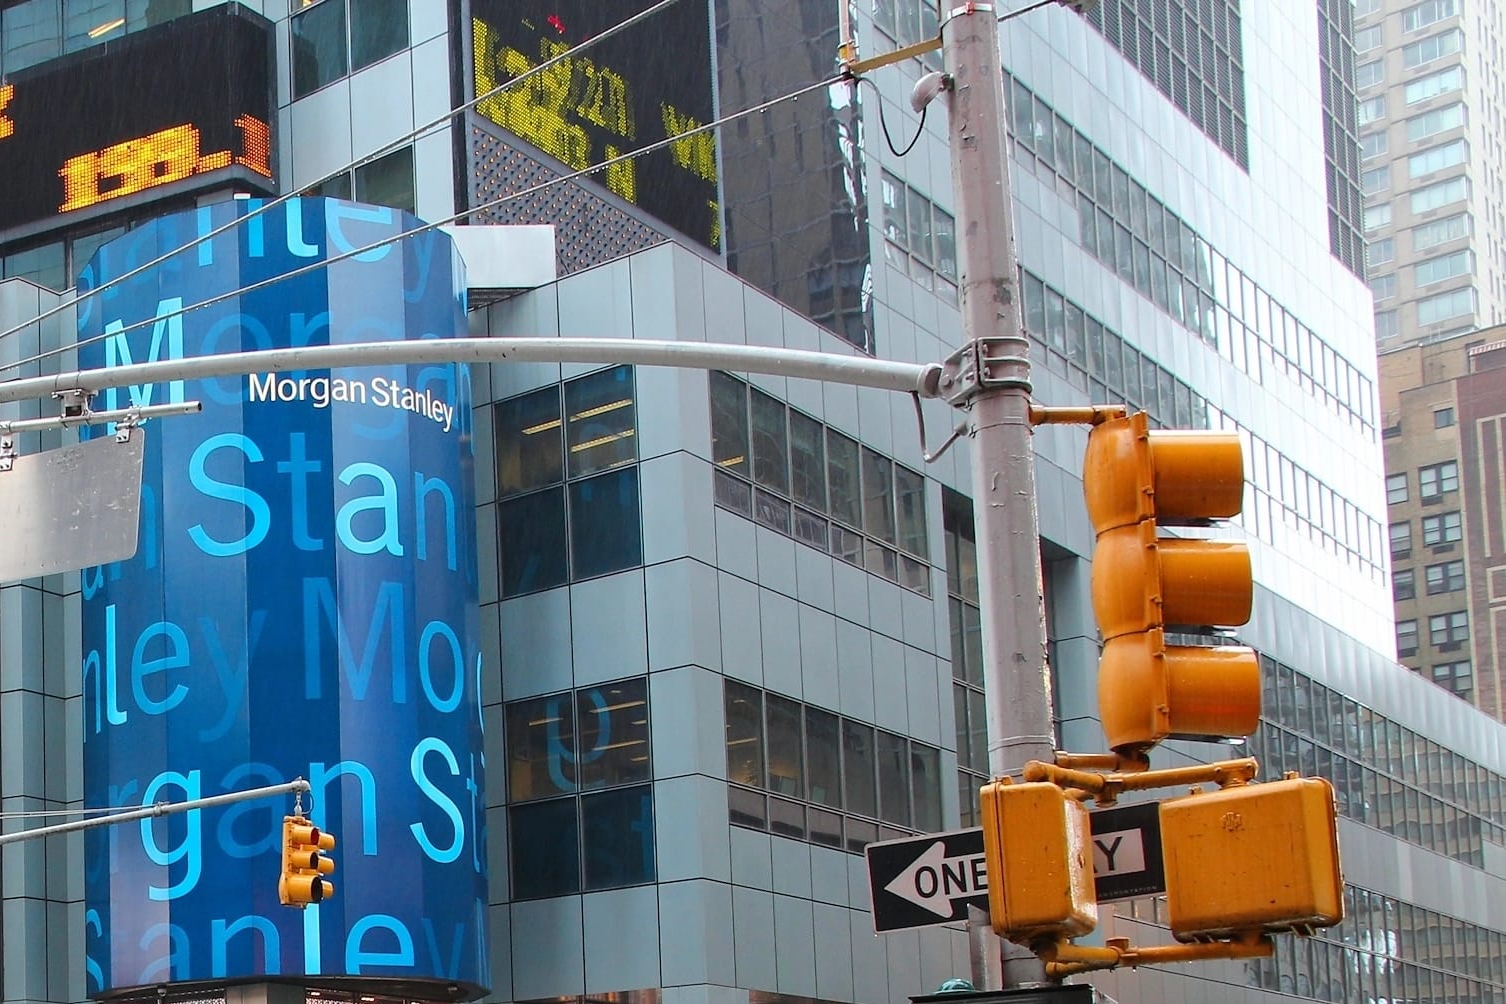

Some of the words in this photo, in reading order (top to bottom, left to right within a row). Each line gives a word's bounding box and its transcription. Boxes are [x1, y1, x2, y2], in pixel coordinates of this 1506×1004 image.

[248, 372, 367, 409] Morgan
[370, 376, 454, 433] Stanley
[914, 857, 988, 900] ONE
